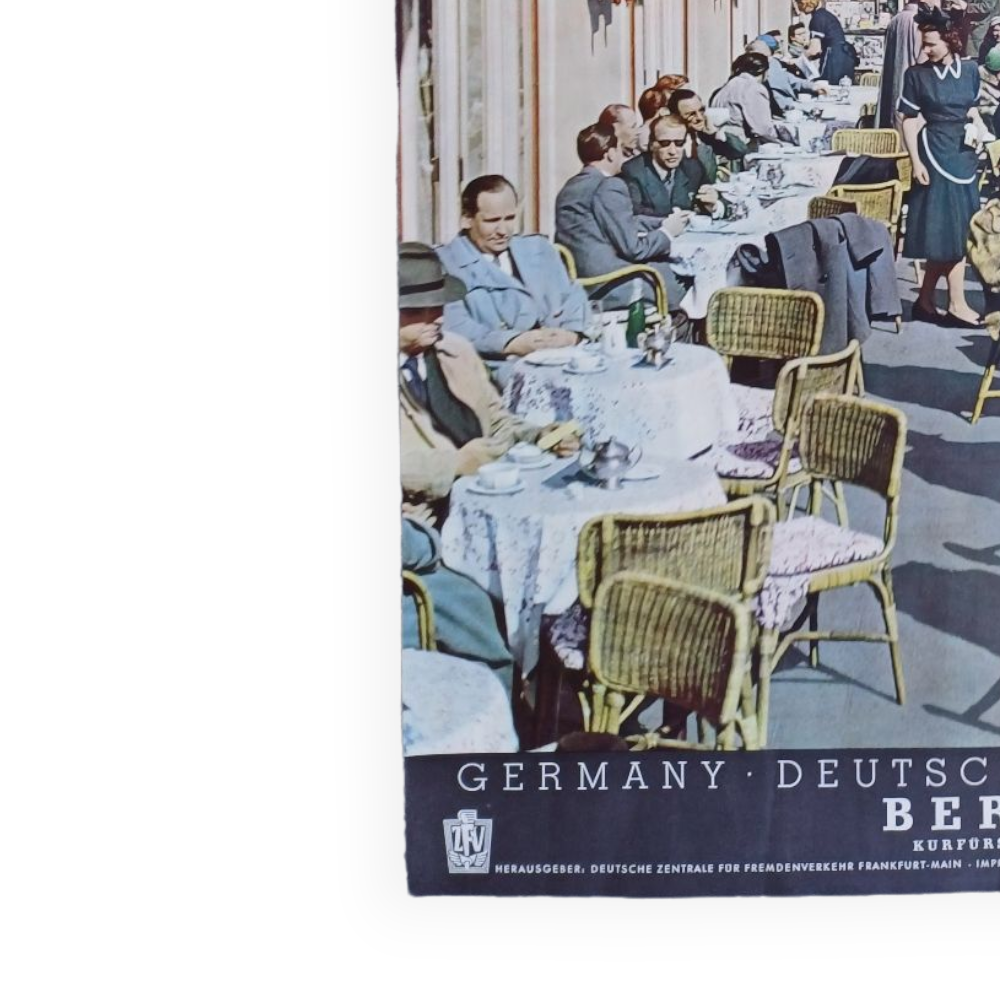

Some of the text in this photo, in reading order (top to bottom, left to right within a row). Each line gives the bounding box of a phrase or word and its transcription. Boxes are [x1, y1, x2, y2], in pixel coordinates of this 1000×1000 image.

[457, 760, 726, 792] GERMANY
[590, 863, 653, 874] DEUTSCHE
[656, 863, 714, 874] ZENTRALE
[743, 861, 855, 873] FREMDENVERKEHR
[858, 859, 963, 871] FRANKFURT-MAIN
